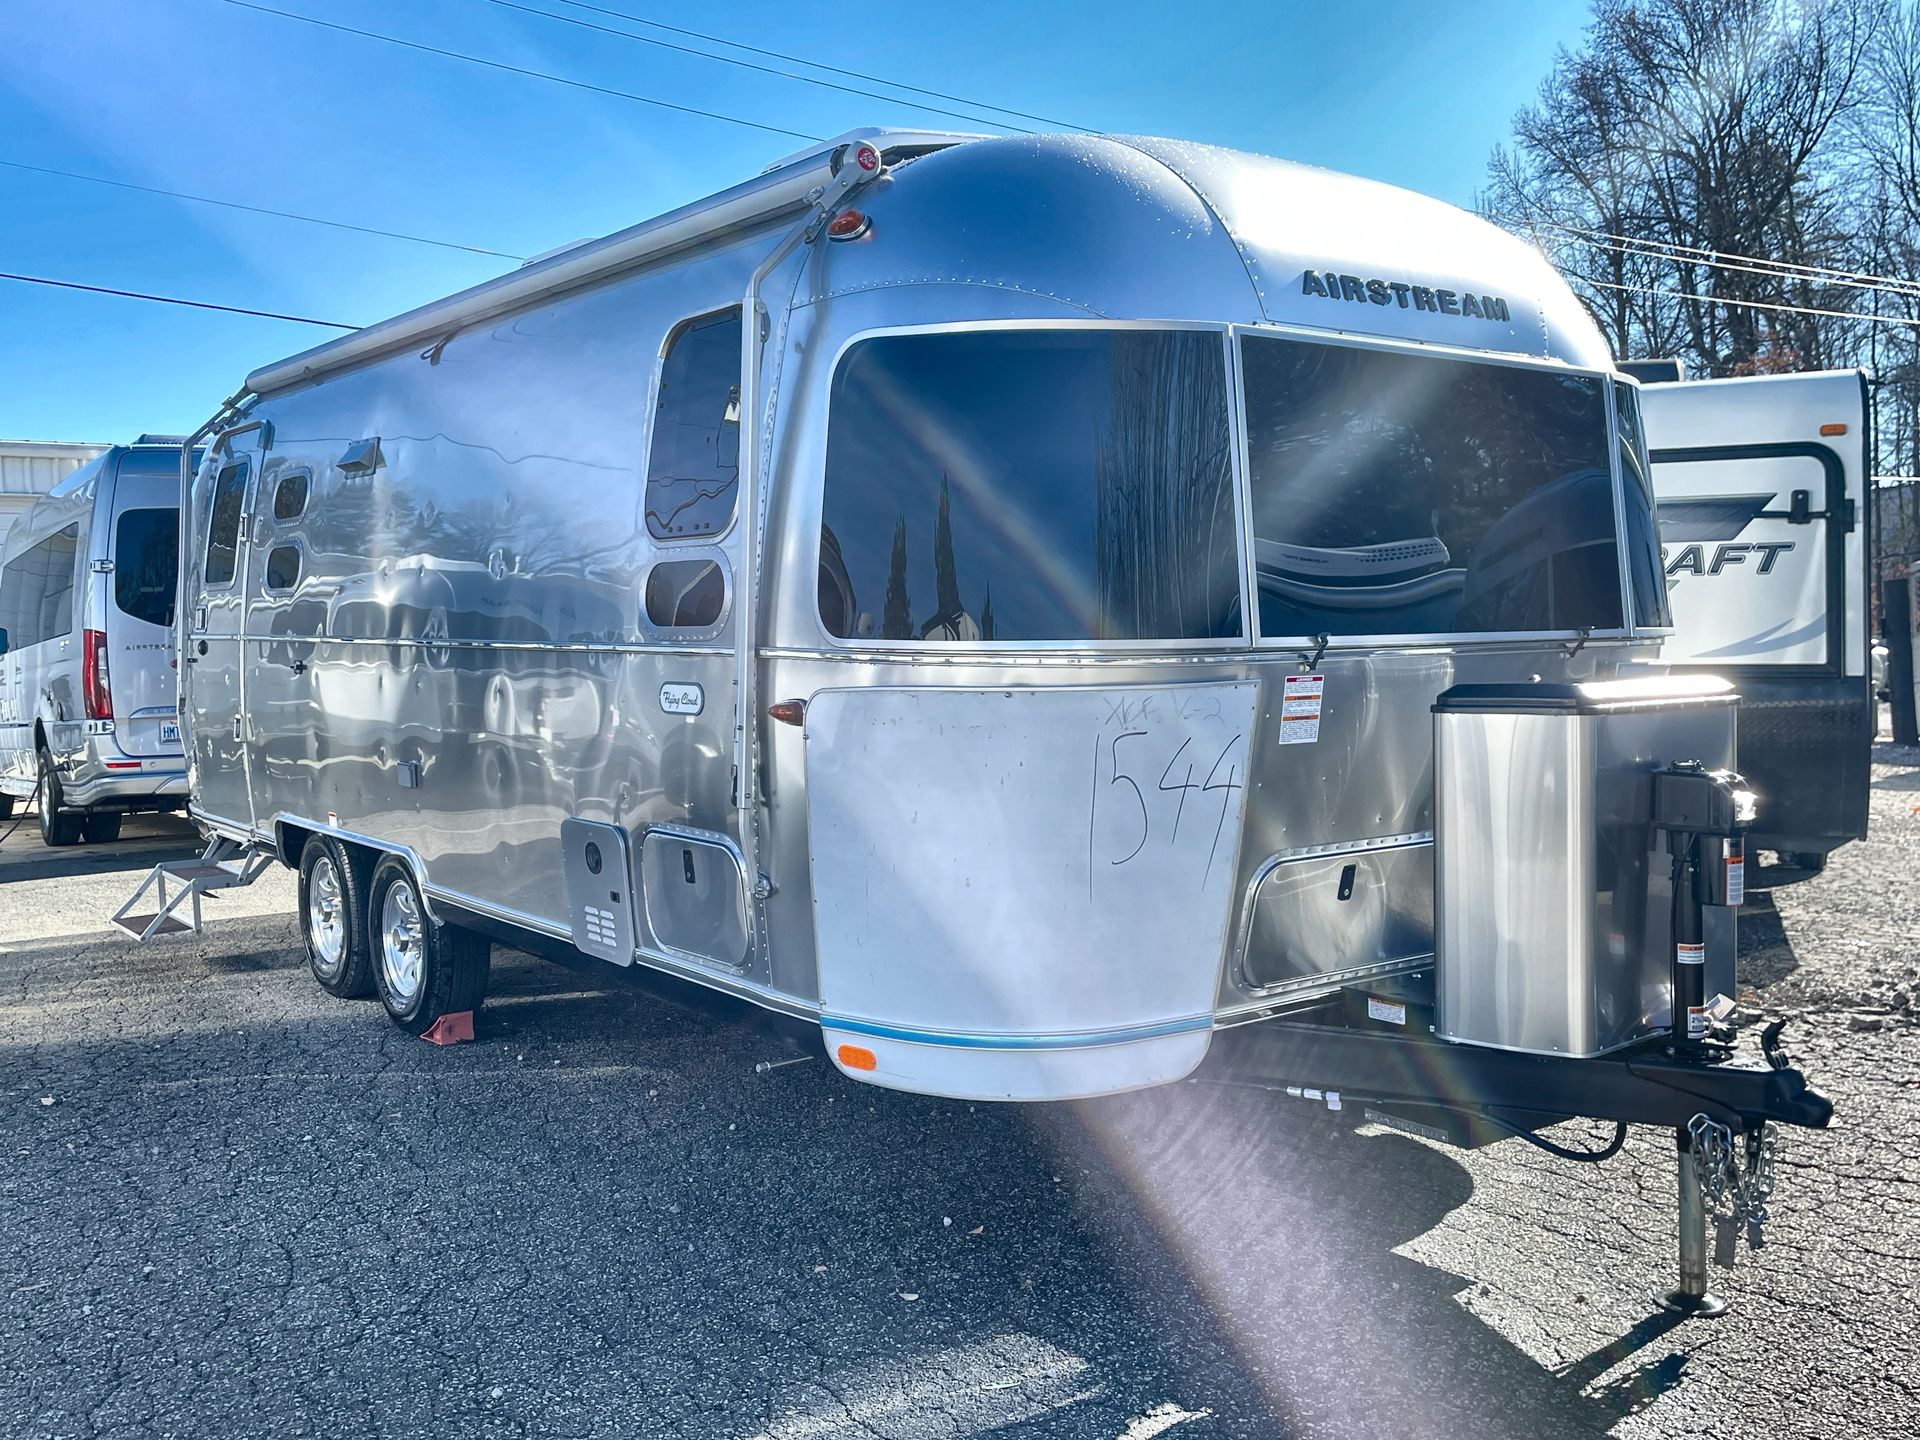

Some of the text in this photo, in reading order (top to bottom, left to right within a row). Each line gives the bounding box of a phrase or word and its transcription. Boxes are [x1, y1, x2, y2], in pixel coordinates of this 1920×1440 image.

[1302, 269, 1511, 322] AIRSTREAM
[1661, 542, 1796, 576] AFT
[125, 644, 173, 652] AIRSTREA
[1089, 731, 1242, 902] 1544
